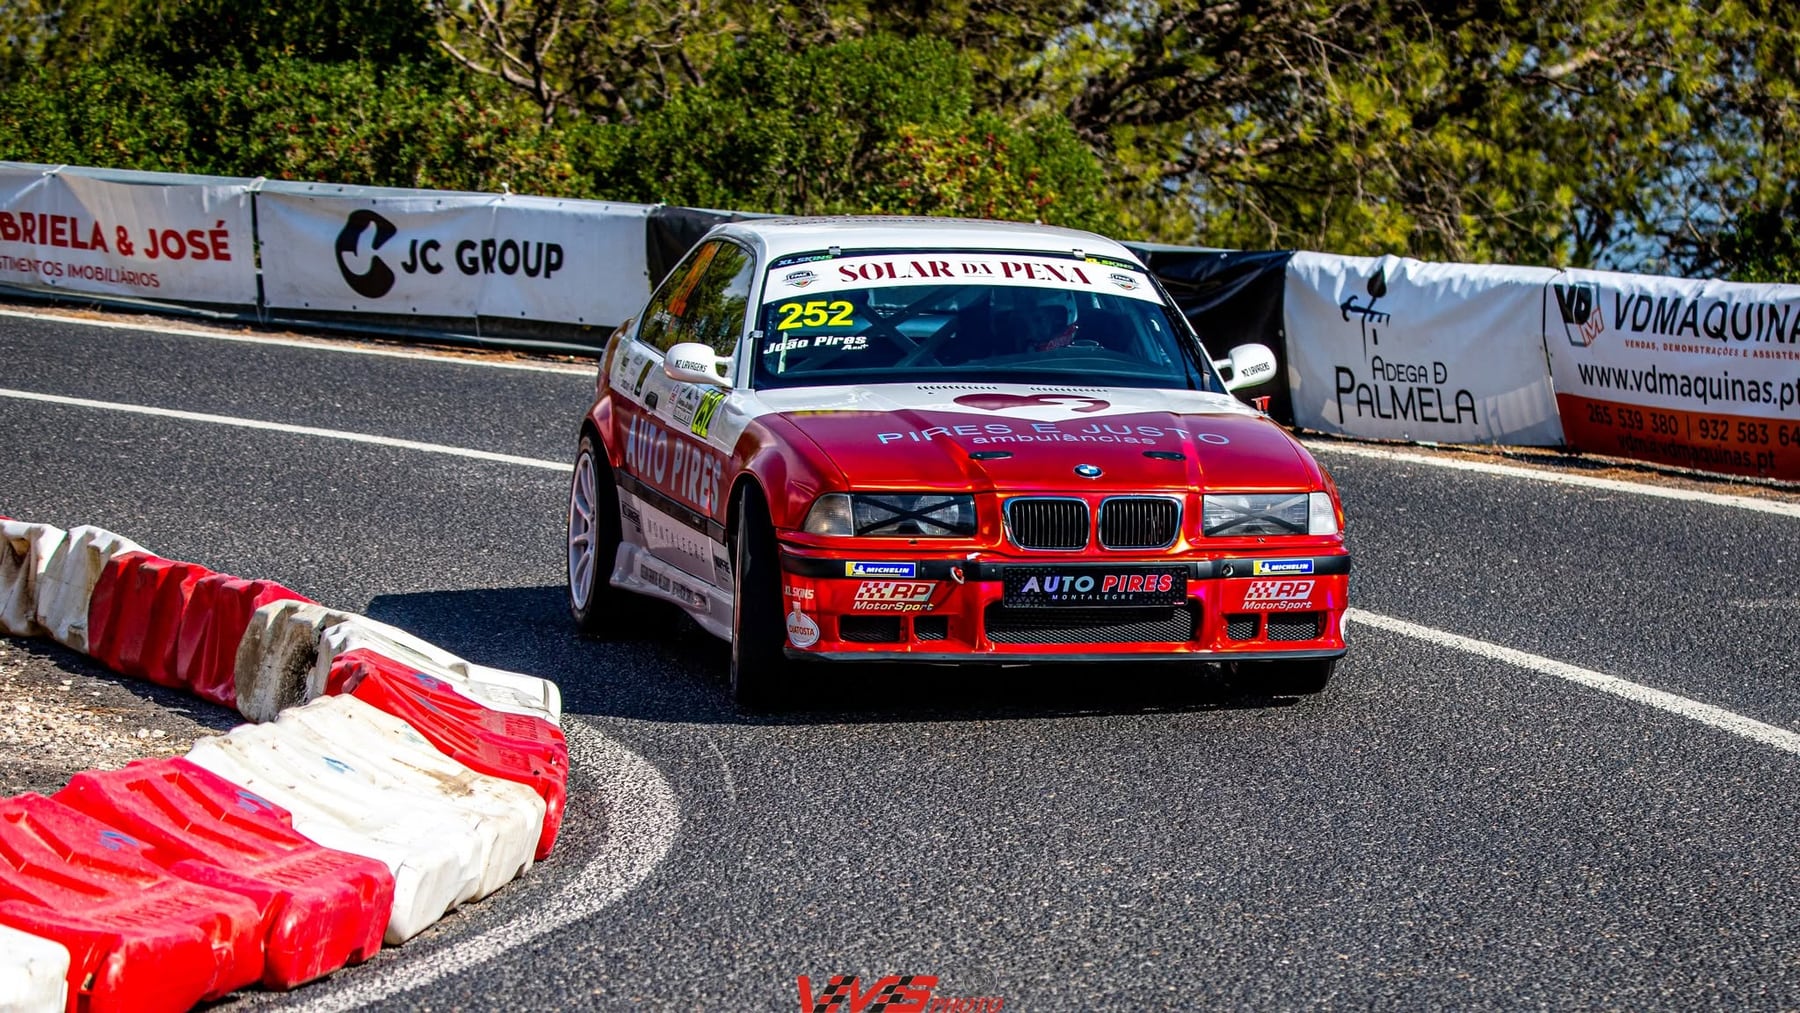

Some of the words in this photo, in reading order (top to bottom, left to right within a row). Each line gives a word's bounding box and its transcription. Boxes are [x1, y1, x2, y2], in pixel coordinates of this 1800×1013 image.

[115, 225, 134, 257] &
[144, 220, 232, 262] JOSÉ
[401, 239, 443, 275] JC
[455, 238, 564, 279] GROUP
[0, 255, 64, 277] TIMENTOS
[67, 263, 160, 288] IMOBILIÁRIOS
[838, 259, 951, 283] SOLAR
[962, 260, 994, 277] DA
[1000, 262, 1092, 285] PENA
[777, 301, 854, 331] 252
[763, 338, 809, 355] João
[814, 335, 867, 347] Pires
[1625, 339, 1659, 352] VENDAS,
[1743, 349, 1748, 358] E
[1371, 355, 1428, 384] ADEGA
[1335, 365, 1478, 424] PALMELA
[1578, 363, 1800, 411] www.vdmaquinas.pt
[877, 423, 1013, 445] PIRES
[1031, 423, 1061, 434] E
[1082, 423, 1230, 446] JUSTO
[1586, 403, 1613, 425] 265
[1618, 408, 1644, 431] 539
[1650, 413, 1679, 435] 380
[1698, 418, 1729, 441] 932
[1737, 422, 1769, 446] 583
[972, 432, 1156, 445] ambulâncias
[625, 413, 668, 485] AUTO
[670, 437, 722, 516] PIRES
[1271, 563, 1309, 571] MICHELIN
[889, 583, 932, 600] RP
[1021, 576, 1095, 593] AUTO
[1102, 575, 1173, 593] PIRES
[1275, 582, 1312, 598] RP
[852, 600, 935, 613] MotorSport
[1241, 600, 1313, 611] MotorSport
